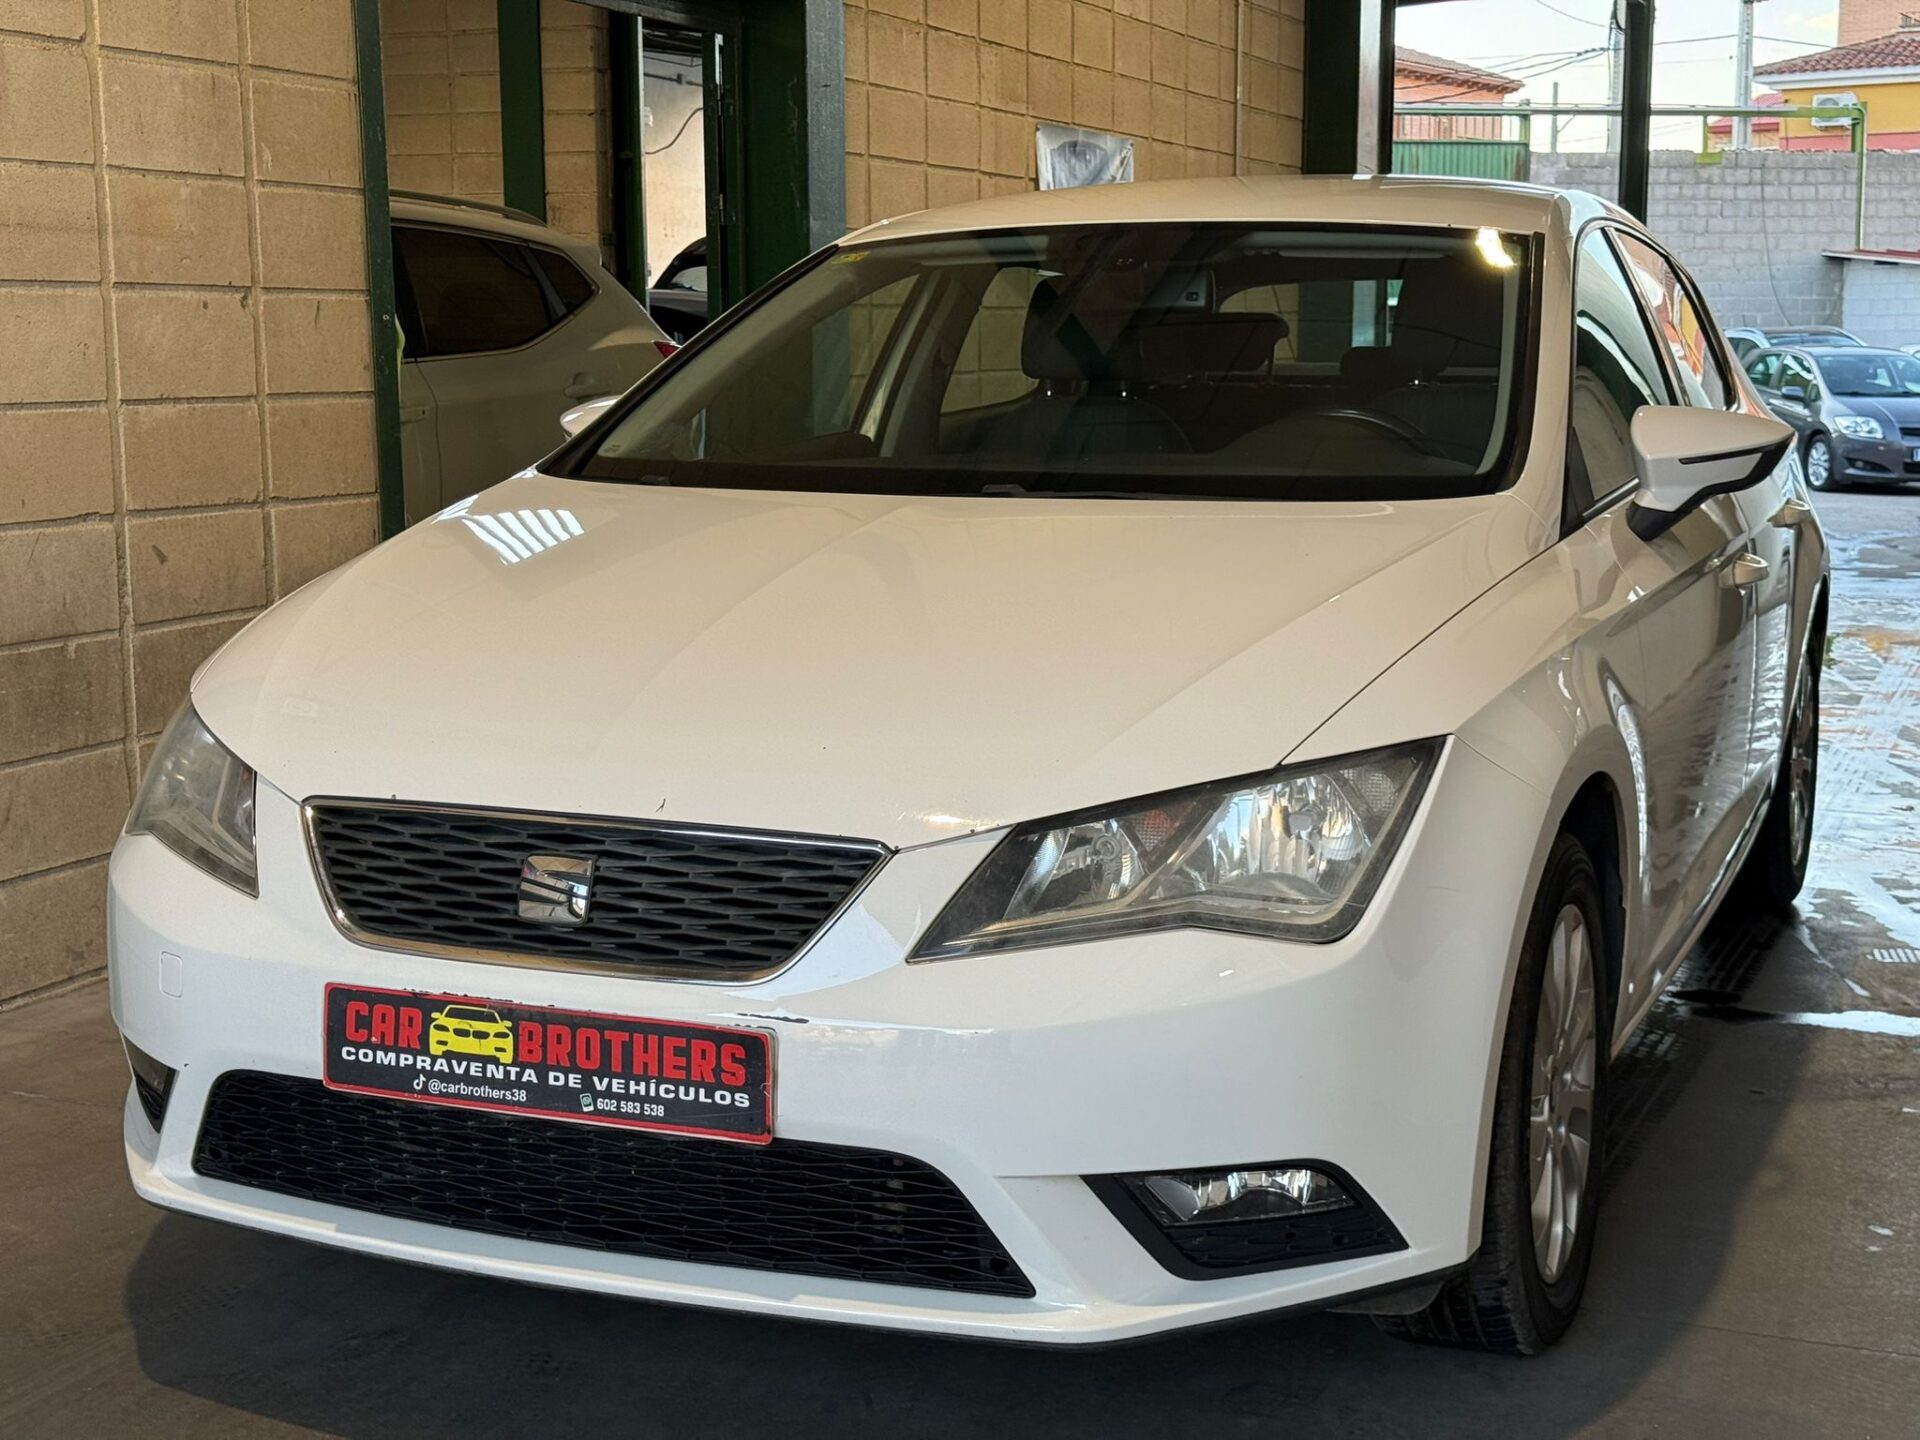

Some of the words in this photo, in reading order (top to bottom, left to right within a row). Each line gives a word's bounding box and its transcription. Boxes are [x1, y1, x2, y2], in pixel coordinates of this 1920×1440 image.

[345, 1001, 423, 1049] CAR
[518, 1021, 746, 1087] BROTHERS
[341, 1046, 538, 1083] COMPRAVENTA
[548, 1071, 582, 1088] DE
[592, 1075, 750, 1108] VEHÍCULOS
[428, 1079, 527, 1102] @carbrothers38
[597, 1098, 617, 1111] 602
[620, 1101, 640, 1114] 583
[643, 1103, 664, 1116] 538
